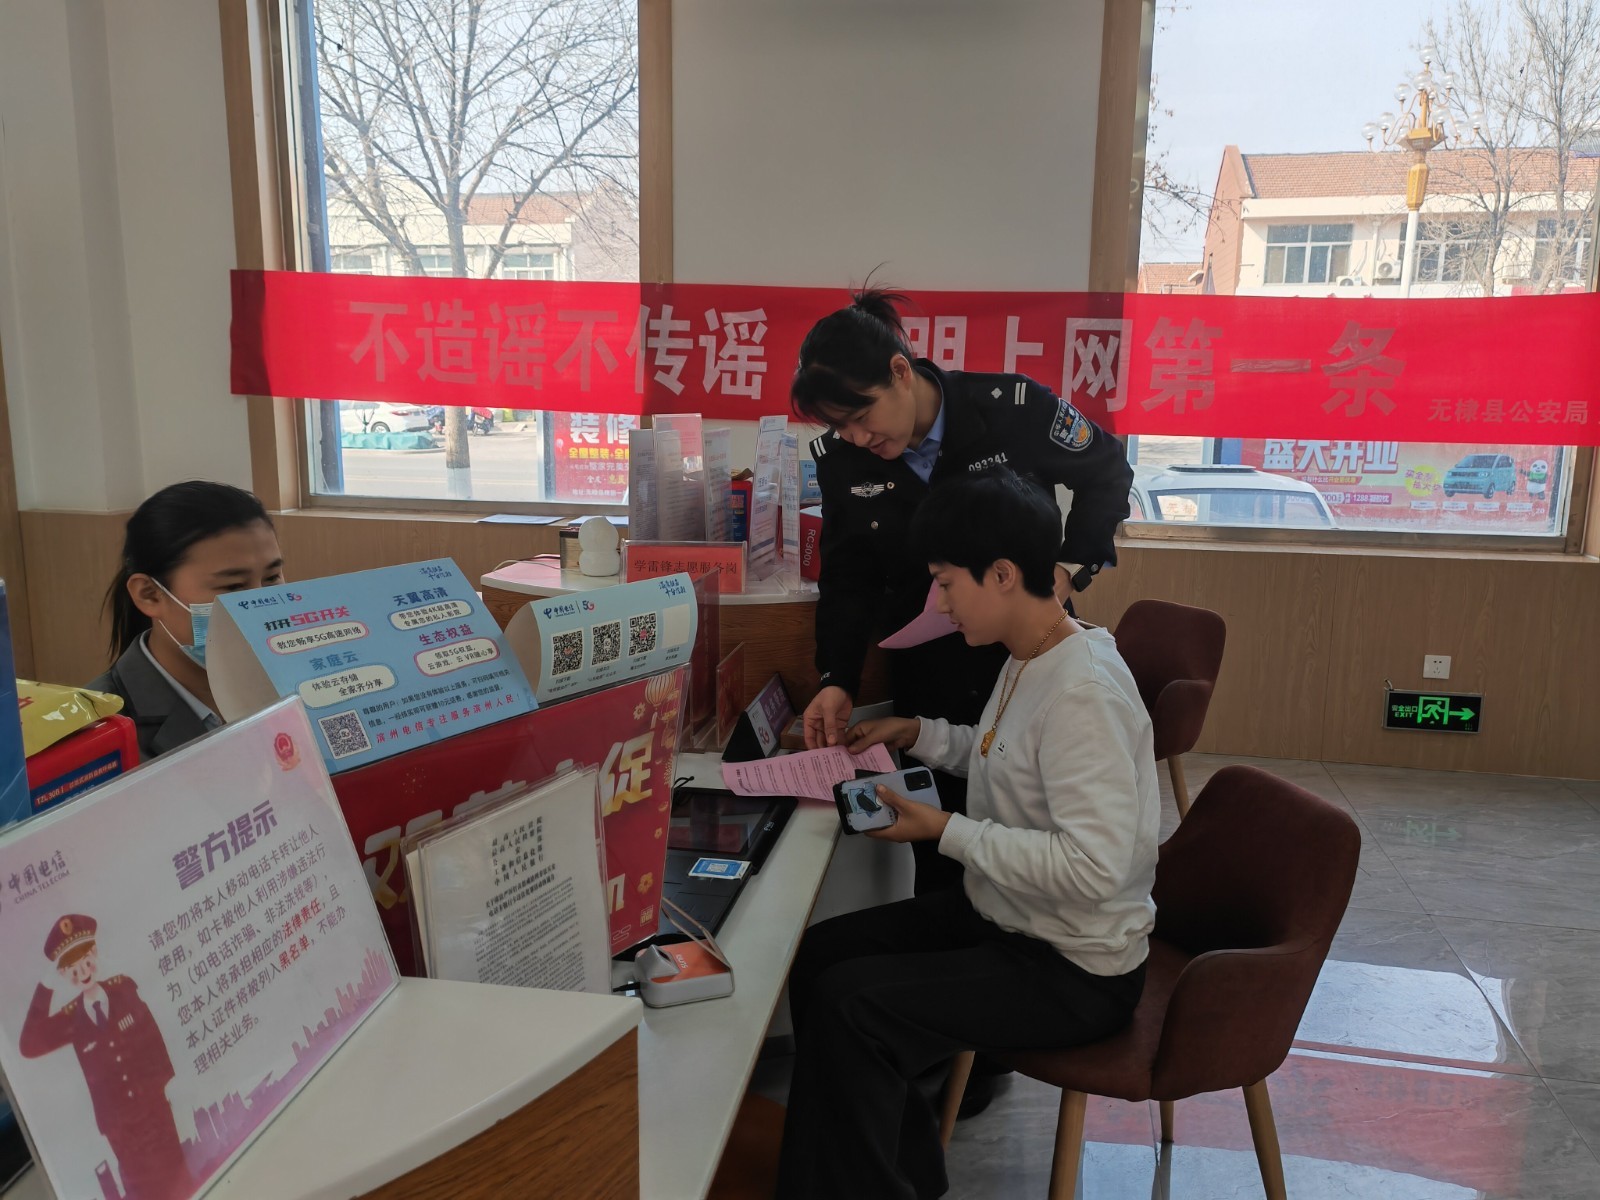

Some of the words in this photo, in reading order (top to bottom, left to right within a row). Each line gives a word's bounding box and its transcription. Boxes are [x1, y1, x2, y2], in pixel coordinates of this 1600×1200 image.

[349, 299, 768, 399] 不造谣不传谣
[1428, 399, 1588, 424] 无棣县公安局
[570, 413, 636, 444] 装修
[1263, 438, 1399, 471] 盛大开业
[803, 528, 816, 567] RC3000
[634, 560, 737, 574] 学雷锋志愿服务岗
[393, 587, 448, 606] 天翼高清
[582, 600, 595, 611] 5G
[264, 606, 350, 631] 打开5G开关
[277, 626, 362, 650] 教您畅享5G高速网络
[419, 624, 474, 646] 生态权益
[309, 651, 359, 671] 家庭云
[311, 673, 359, 691] 体验云存储
[338, 678, 384, 697] 全家齐分享
[172, 800, 278, 890] 警方提示
[15, 888, 38, 904] CHINA
[38, 869, 70, 892] TELECOM
[148, 823, 320, 951] 请您勿将本人移动电话卡转让他人
[158, 843, 327, 977] 使用，如卡被他人利用涉嫌违法行
[177, 883, 341, 1027] 您本人将承担相应的法律责任，且
[185, 905, 347, 1050] 本人证件将被列入黑名单，不能办
[193, 1016, 260, 1076] 理相关业务。
